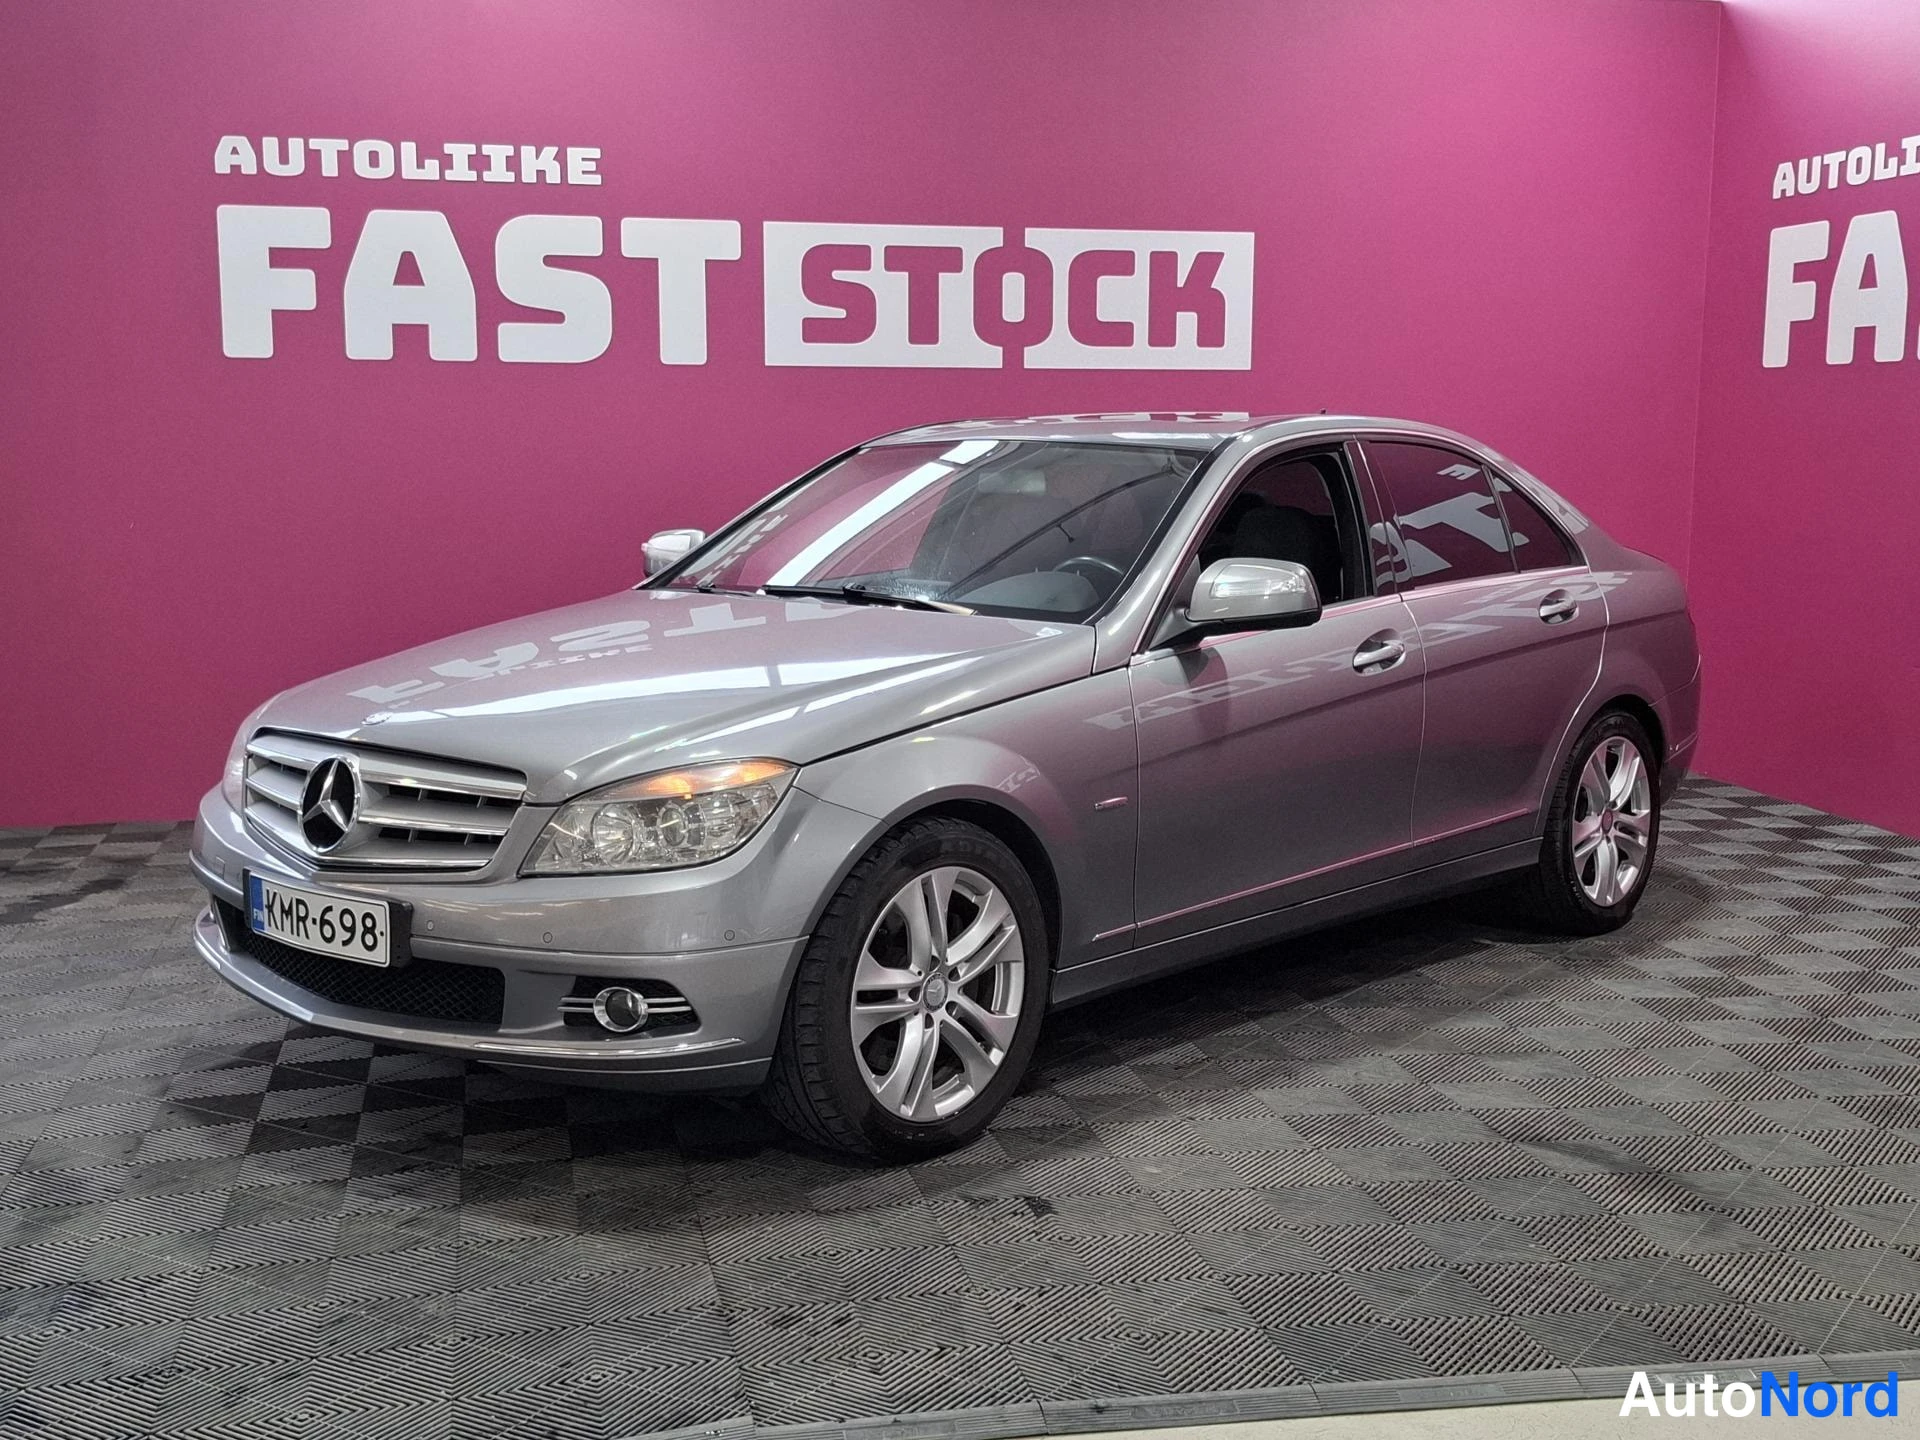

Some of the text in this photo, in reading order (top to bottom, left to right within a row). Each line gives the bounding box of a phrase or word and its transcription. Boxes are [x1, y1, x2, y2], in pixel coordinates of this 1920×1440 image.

[214, 135, 602, 186] AUTOLIIKE
[216, 204, 1226, 365] FAST STOCK
[1762, 210, 1920, 368] FA
[265, 889, 378, 952] KMR-698
